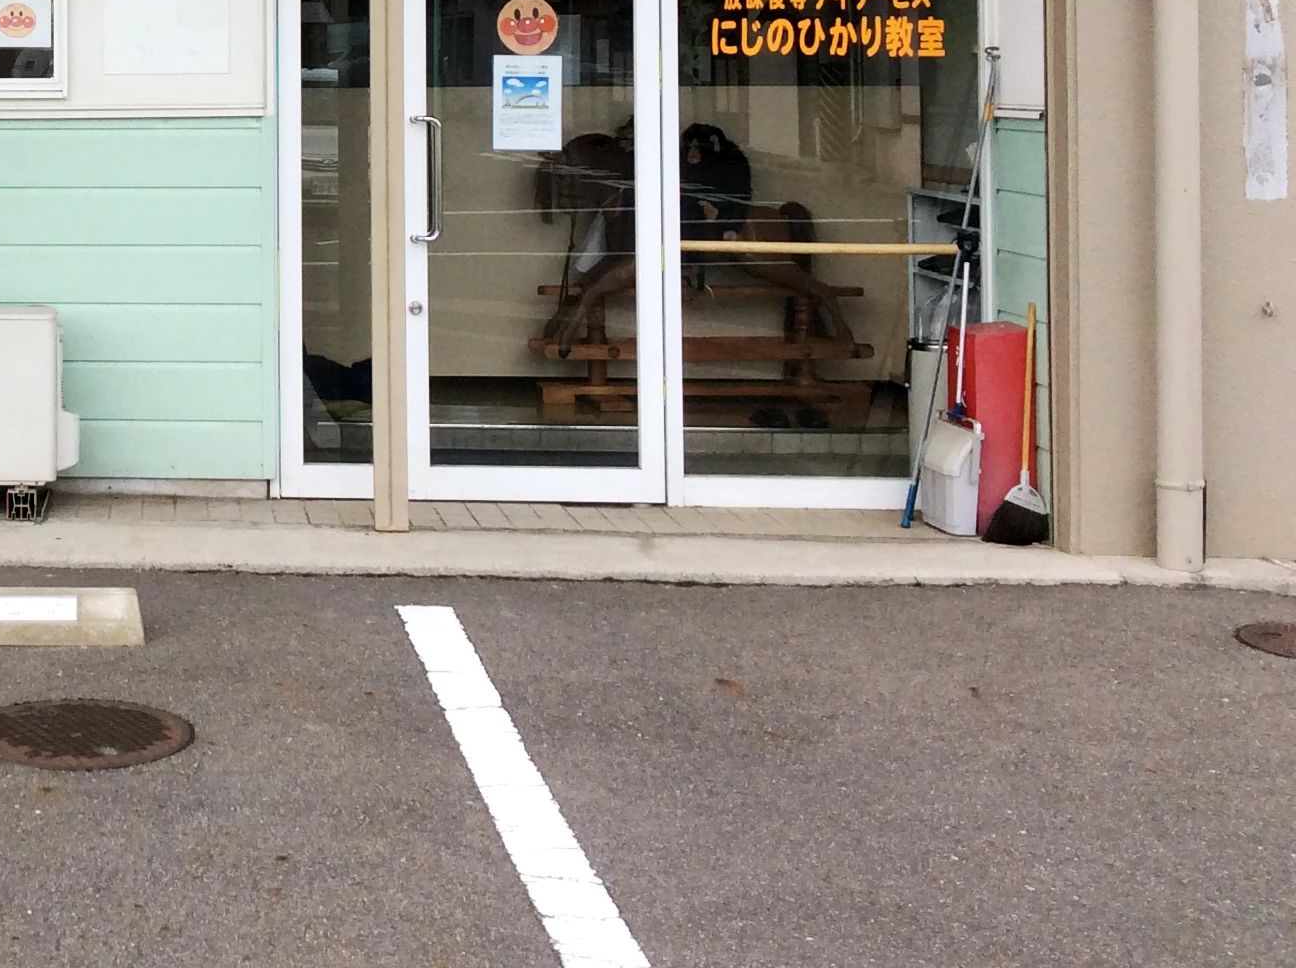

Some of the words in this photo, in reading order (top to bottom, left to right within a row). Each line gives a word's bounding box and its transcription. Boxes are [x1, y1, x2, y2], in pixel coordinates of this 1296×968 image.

[711, 16, 946, 57] にじのひかり教室
